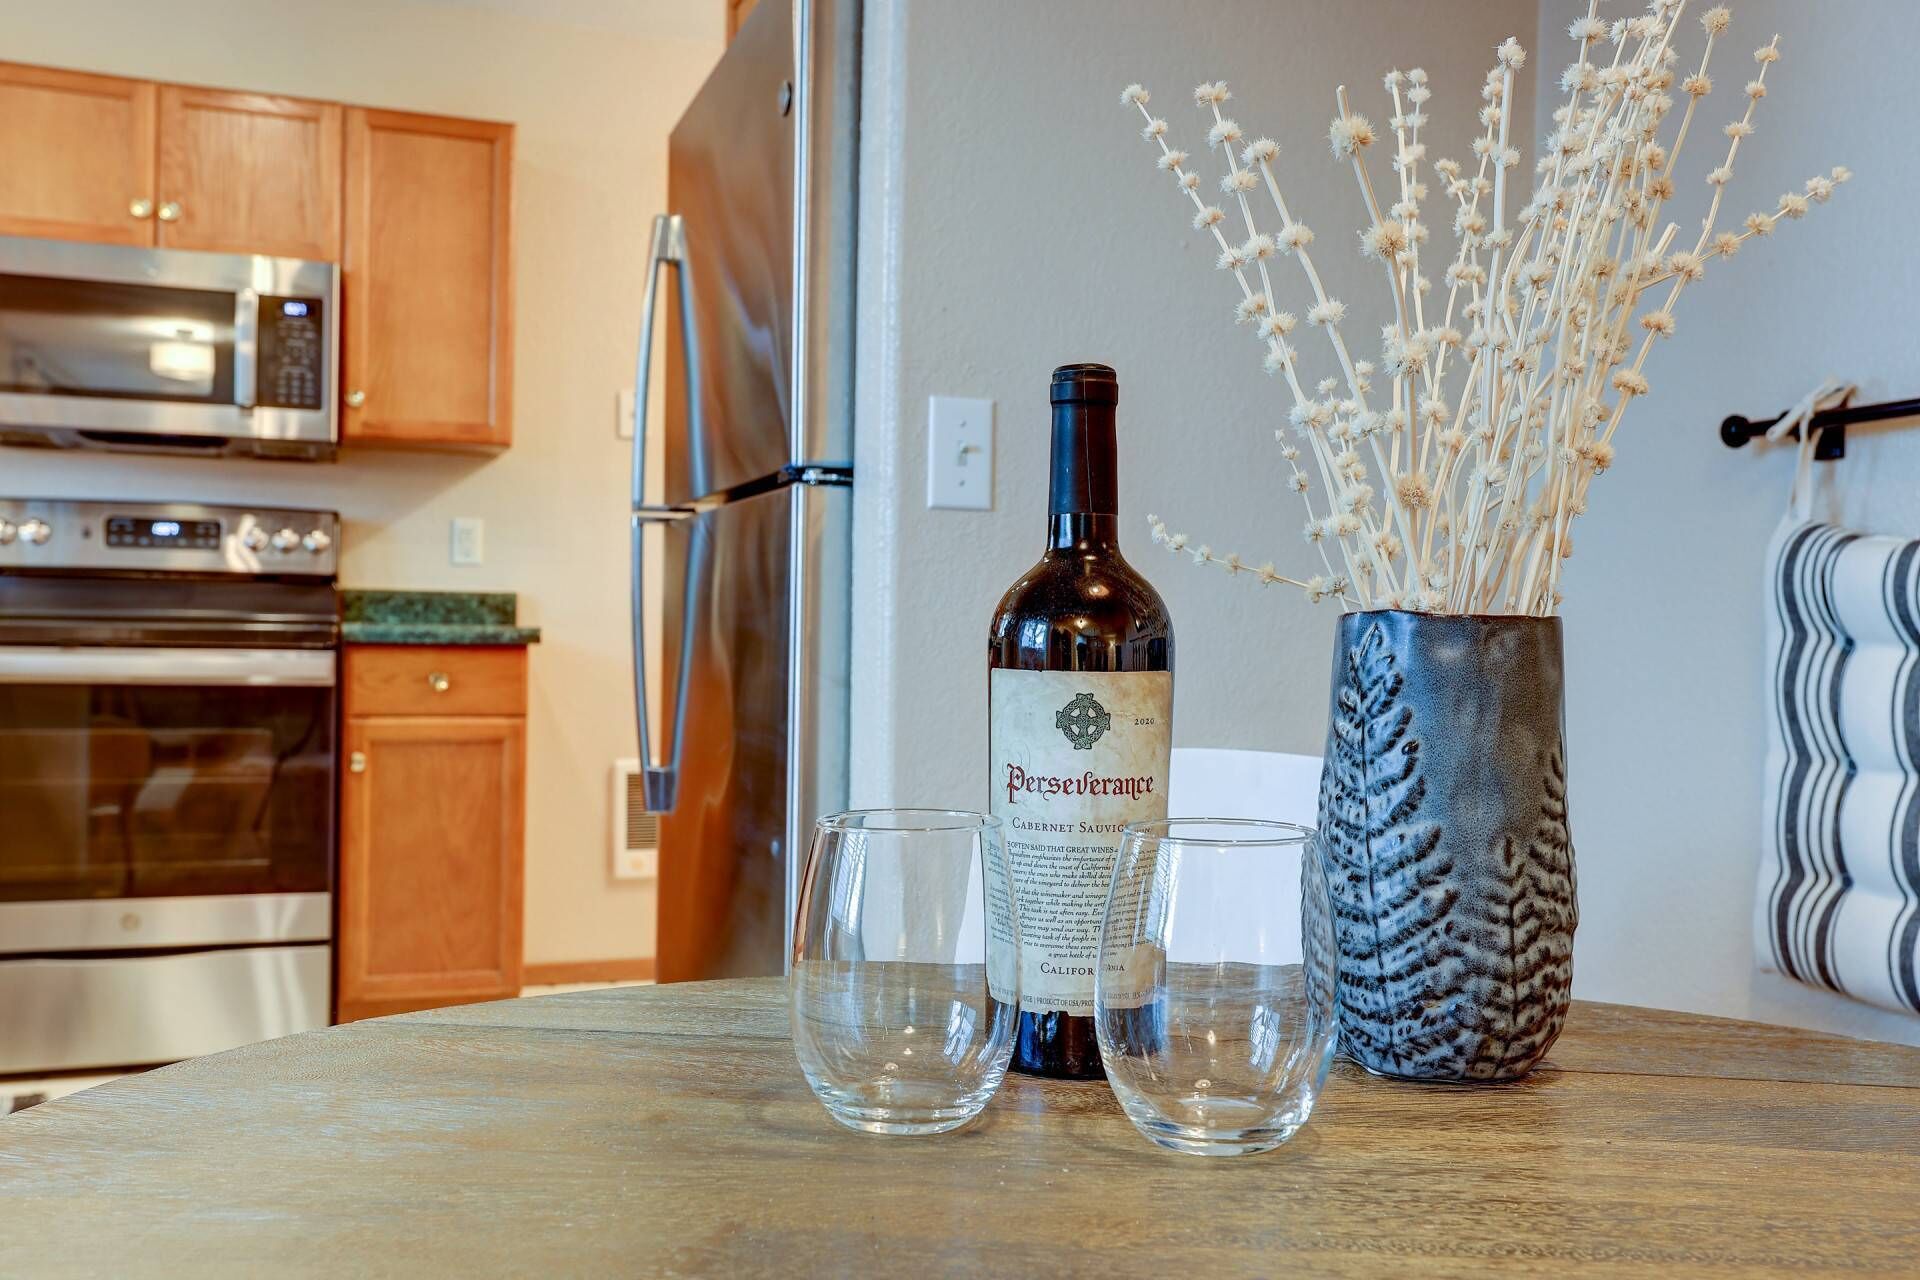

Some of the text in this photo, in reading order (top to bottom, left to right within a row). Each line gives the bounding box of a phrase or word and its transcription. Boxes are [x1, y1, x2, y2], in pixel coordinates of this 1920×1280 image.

[1134, 717, 1155, 726] 2020
[1006, 762, 1154, 804] Perseverance
[1012, 816, 1075, 833] CABERNET
[1030, 843, 1046, 852] SAID
[1046, 845, 1065, 853] THAT
[1090, 846, 1114, 854] WINES
[1072, 856, 1104, 864] importance
[1106, 854, 1112, 864] of
[1074, 864, 1080, 872] of
[1081, 862, 1110, 872] California
[1040, 891, 1070, 899] winemaker
[1025, 897, 1044, 905] together
[1062, 900, 1082, 908] making
[1019, 903, 1030, 912] This
[1060, 908, 1074, 916] often
[1054, 932, 1061, 942] of
[1061, 932, 1070, 940] the
[1072, 933, 1090, 943] people
[1084, 952, 1090, 960] of
[1038, 997, 1060, 1006] PRODUCT
